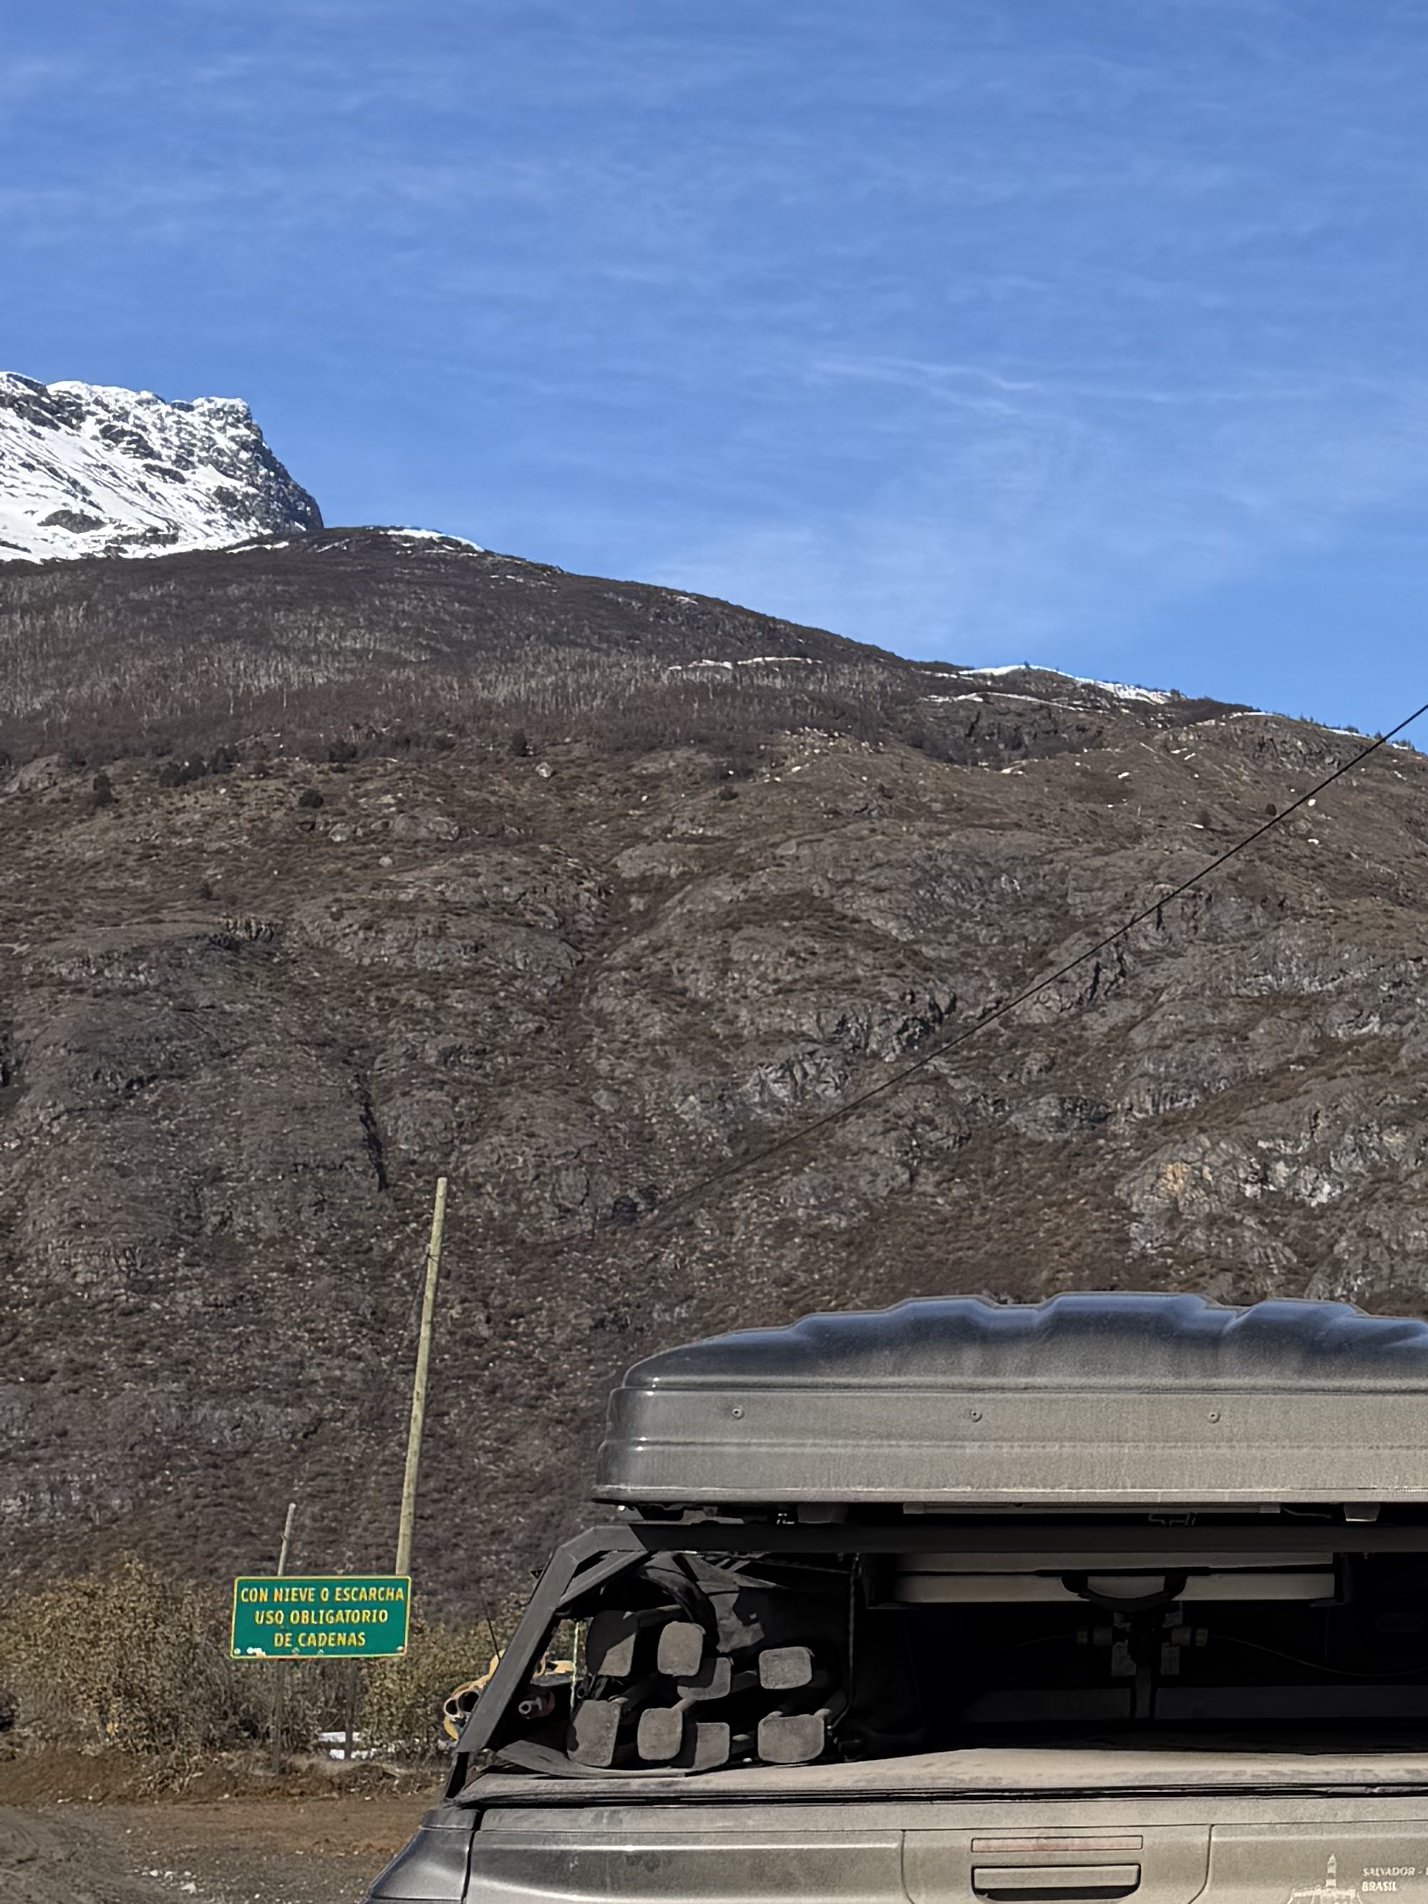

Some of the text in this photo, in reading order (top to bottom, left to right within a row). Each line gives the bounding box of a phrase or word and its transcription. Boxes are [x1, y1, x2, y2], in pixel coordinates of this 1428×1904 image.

[241, 1586, 404, 1602] CON NIEVE O ESCARCHA
[255, 1609, 388, 1625] USO OBLIGATORIO
[274, 1631, 366, 1647] DE CADENAS
[1363, 1866, 1415, 1877] SALVADOR
[1361, 1881, 1397, 1892] BRASIL
